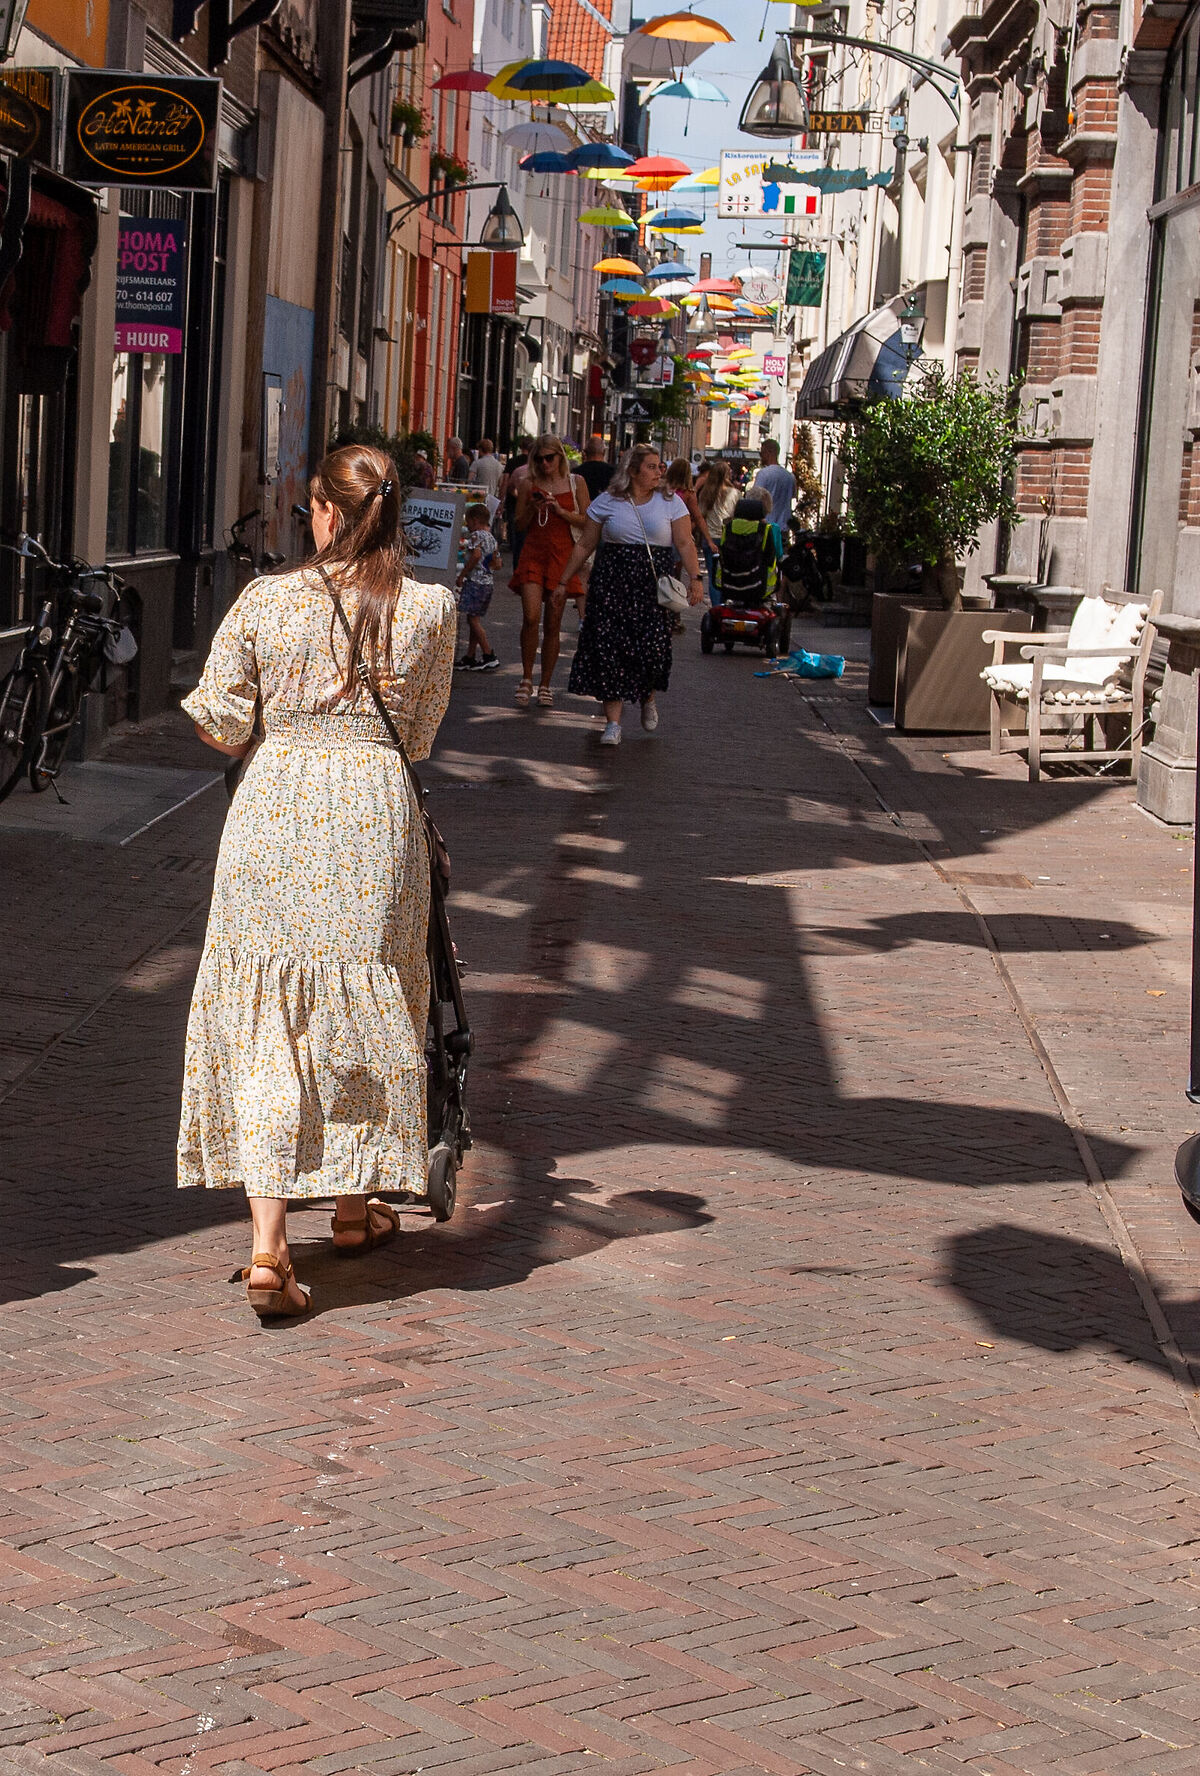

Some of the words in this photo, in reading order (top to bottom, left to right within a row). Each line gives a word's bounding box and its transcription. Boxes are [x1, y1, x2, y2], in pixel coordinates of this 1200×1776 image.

[809, 114, 865, 130] RETA
[95, 142, 119, 151] LATIN
[120, 143, 161, 152] AMERICAN
[162, 143, 187, 153] GRILL
[724, 152, 768, 160] Ristorante
[118, 231, 178, 253] HOMA
[121, 251, 170, 273] POST
[116, 275, 177, 287] RIJFSMAKELAARS
[116, 290, 128, 300] 70
[136, 291, 153, 301] 614
[155, 292, 174, 302] 607
[114, 331, 121, 345] E
[127, 332, 170, 348] HUUR
[765, 359, 786, 367] HOLY
[765, 365, 784, 373] COW
[402, 504, 455, 520] ARPARTNERS
